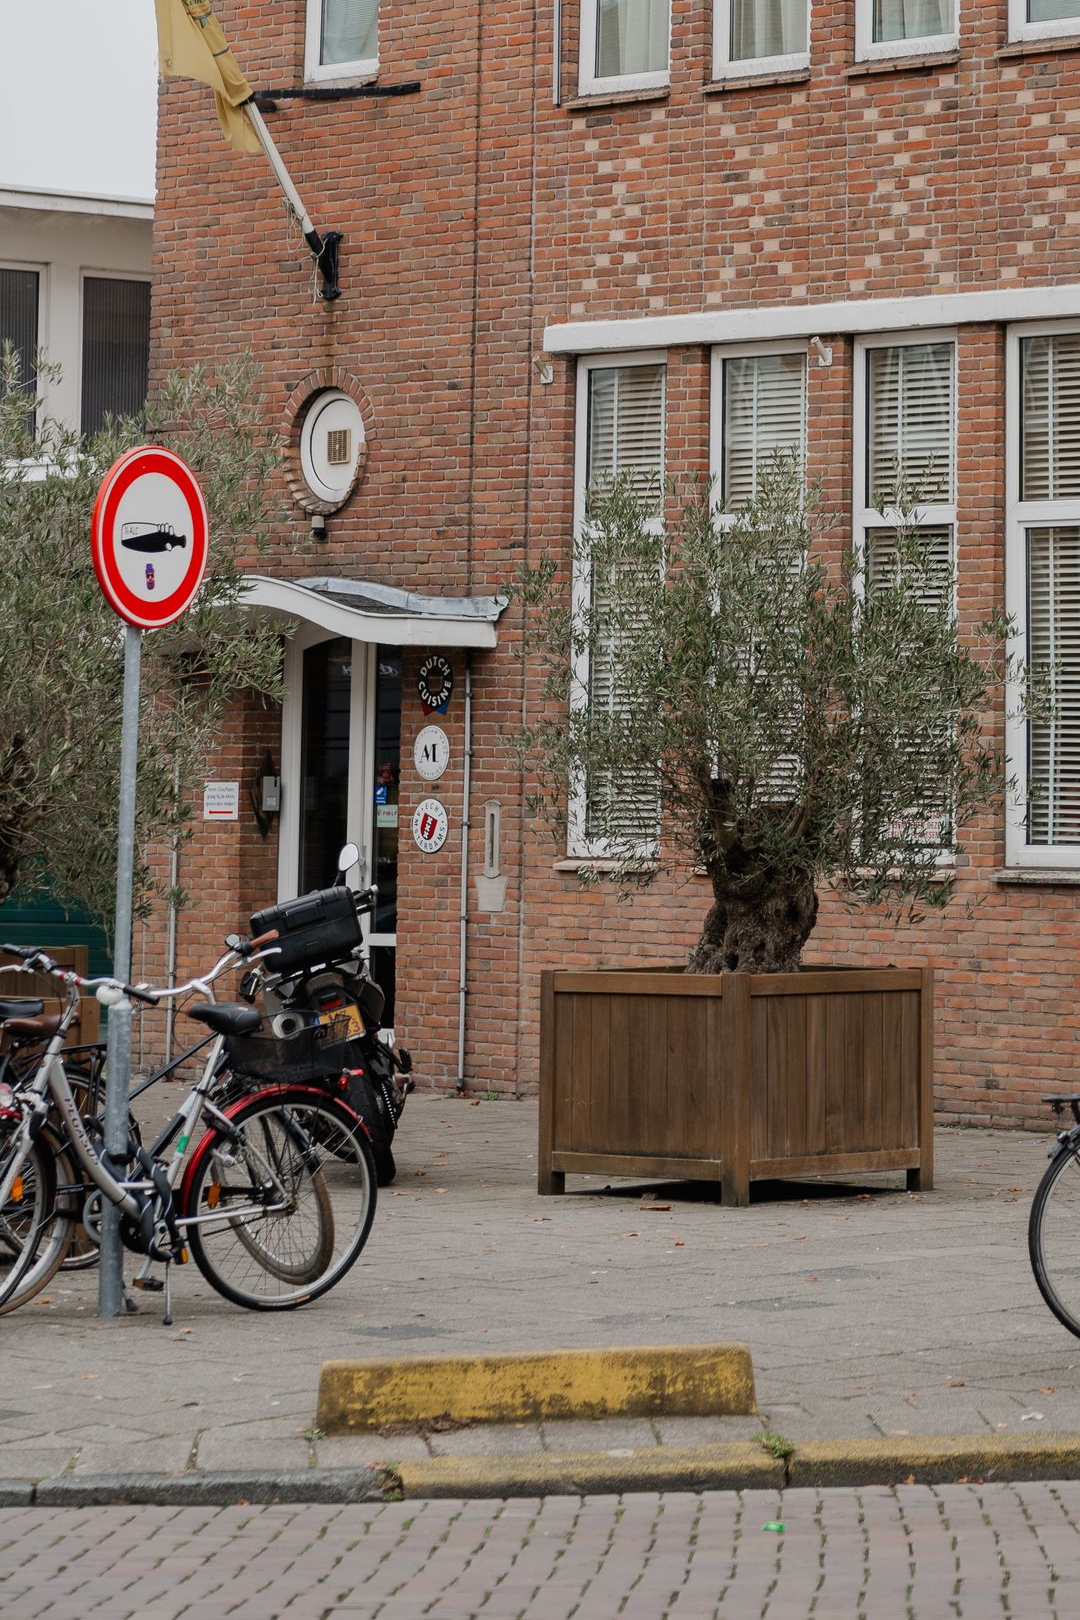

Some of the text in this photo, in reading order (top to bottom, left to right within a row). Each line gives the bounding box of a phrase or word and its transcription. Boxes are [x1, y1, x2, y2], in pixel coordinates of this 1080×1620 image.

[420, 655, 451, 677] DUTCH
[418, 680, 452, 707] CUISINE
[425, 802, 443, 817] ECHT
[414, 811, 445, 850] AMSTERDAMS
